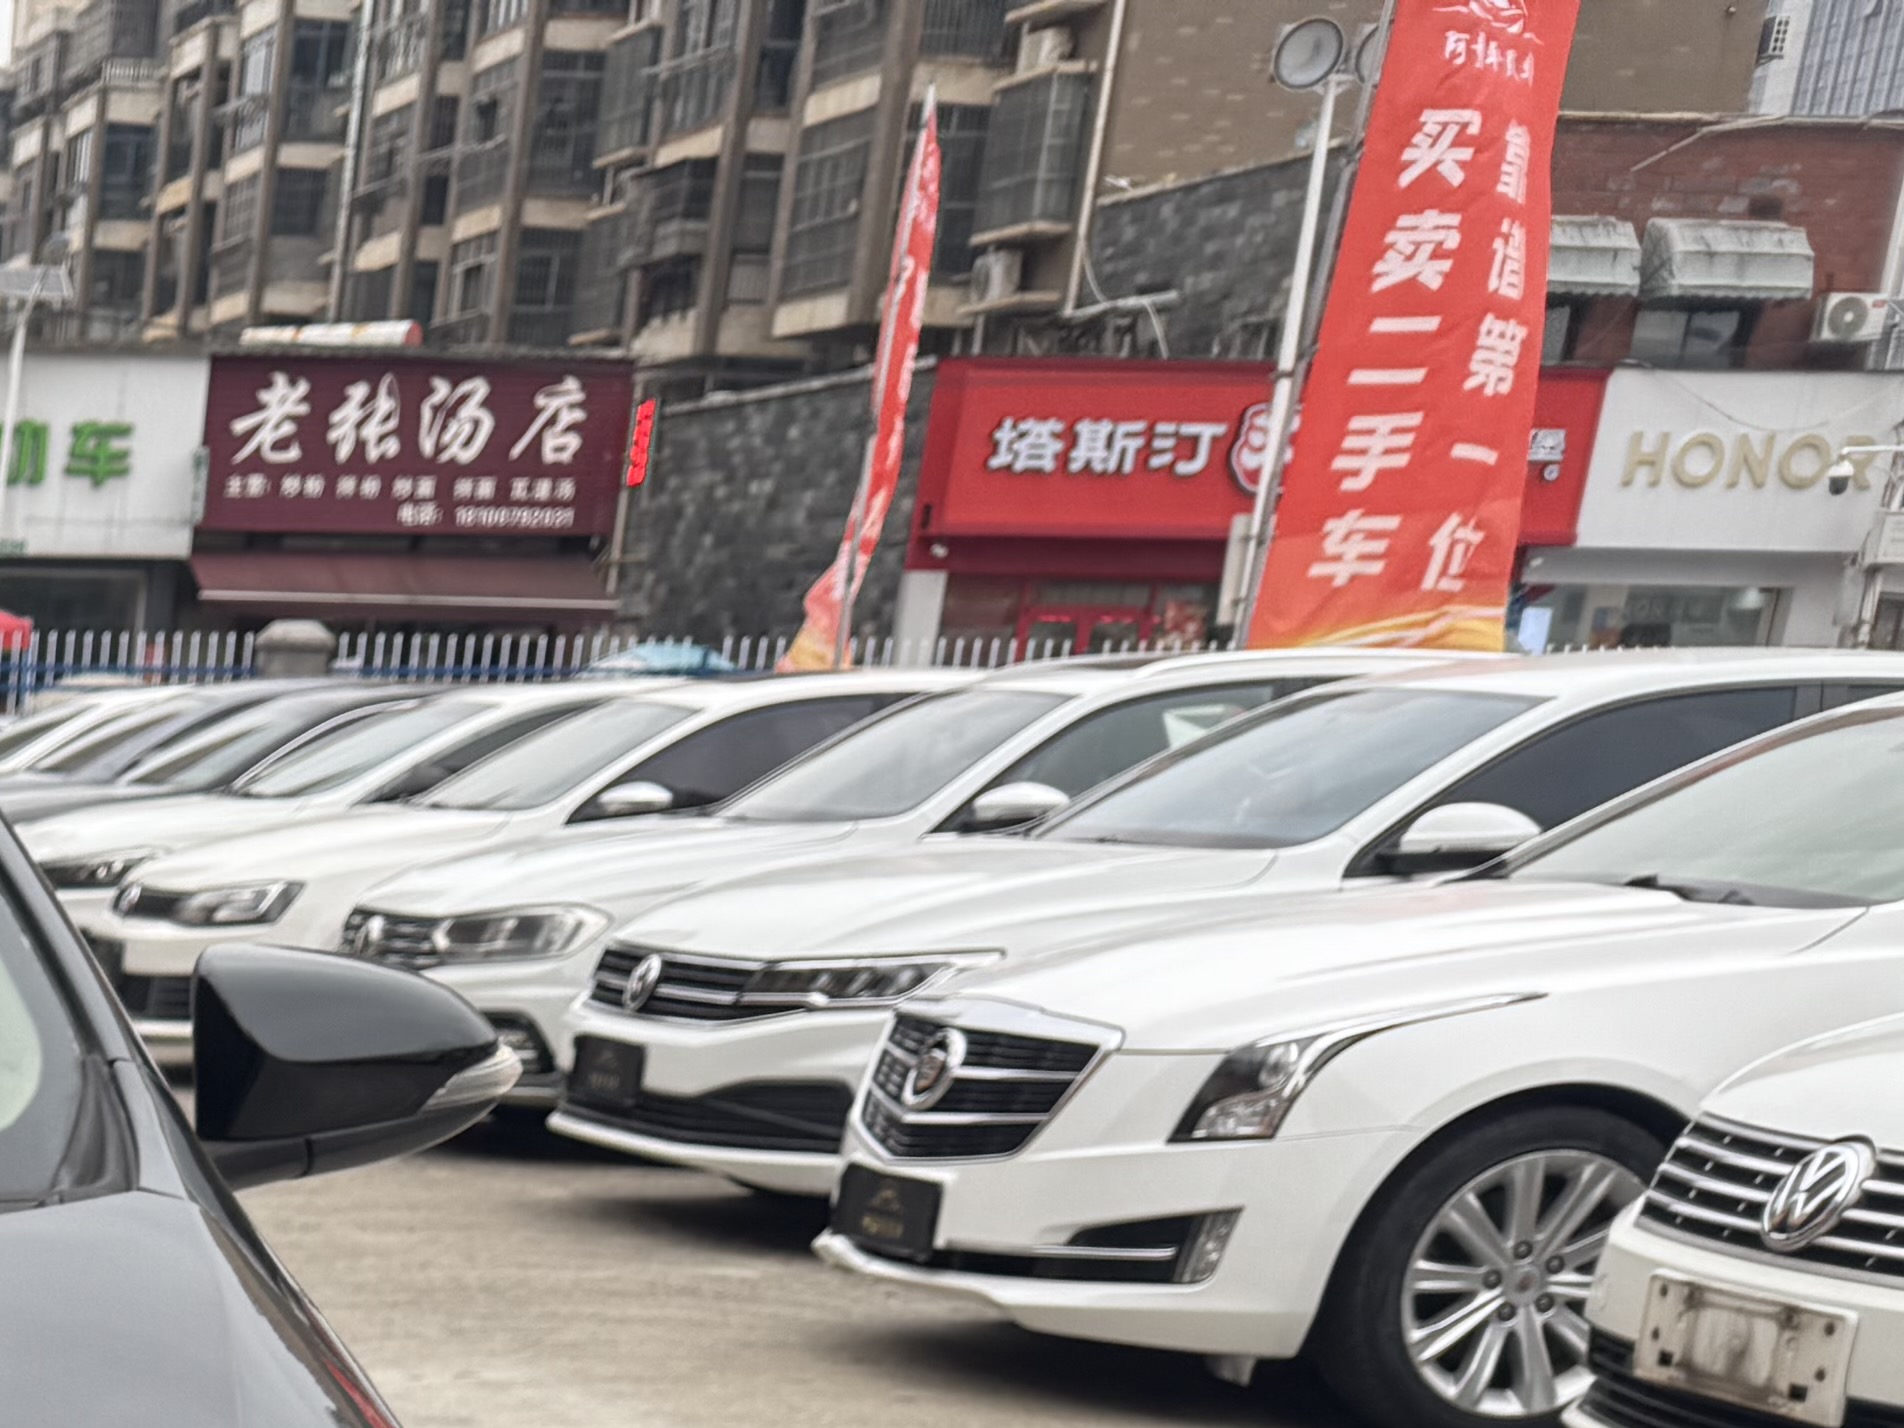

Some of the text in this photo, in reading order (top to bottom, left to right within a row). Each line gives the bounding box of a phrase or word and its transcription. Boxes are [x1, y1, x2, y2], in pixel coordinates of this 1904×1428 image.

[1307, 107, 1482, 588] 买卖二手车
[229, 370, 589, 466] 老张汤店
[987, 417, 1229, 475] 塔斯汀
[1621, 430, 1878, 492] HONOR
